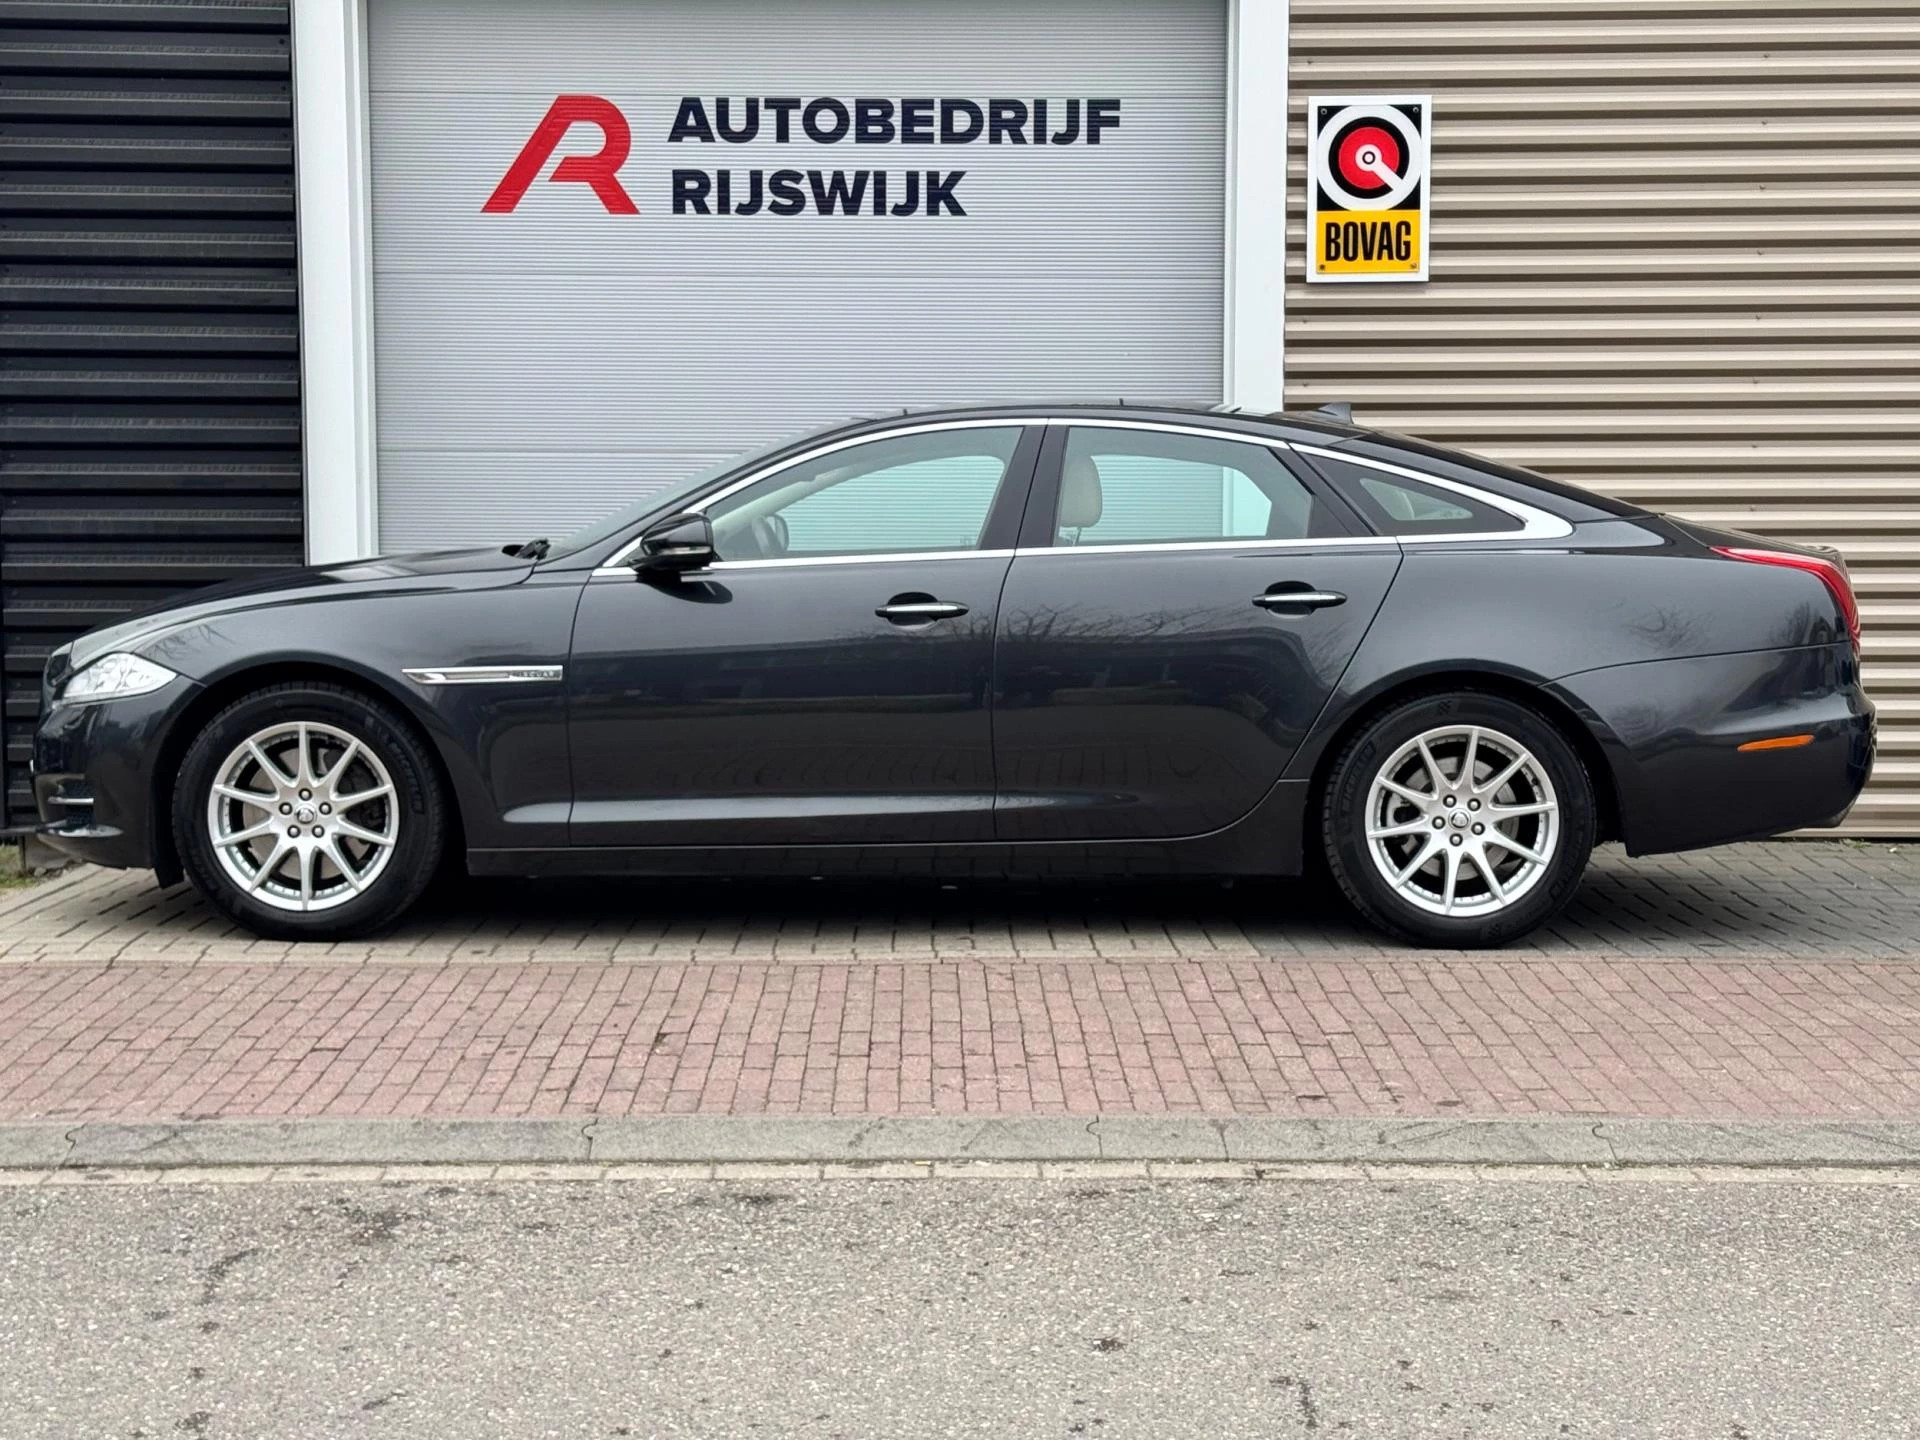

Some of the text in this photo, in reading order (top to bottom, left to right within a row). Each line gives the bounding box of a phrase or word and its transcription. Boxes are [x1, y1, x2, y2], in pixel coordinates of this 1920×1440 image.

[667, 97, 1121, 145] AUTOBEDRIJF
[672, 168, 967, 216] RIJSWIJK
[1325, 221, 1411, 262] BOVAG
